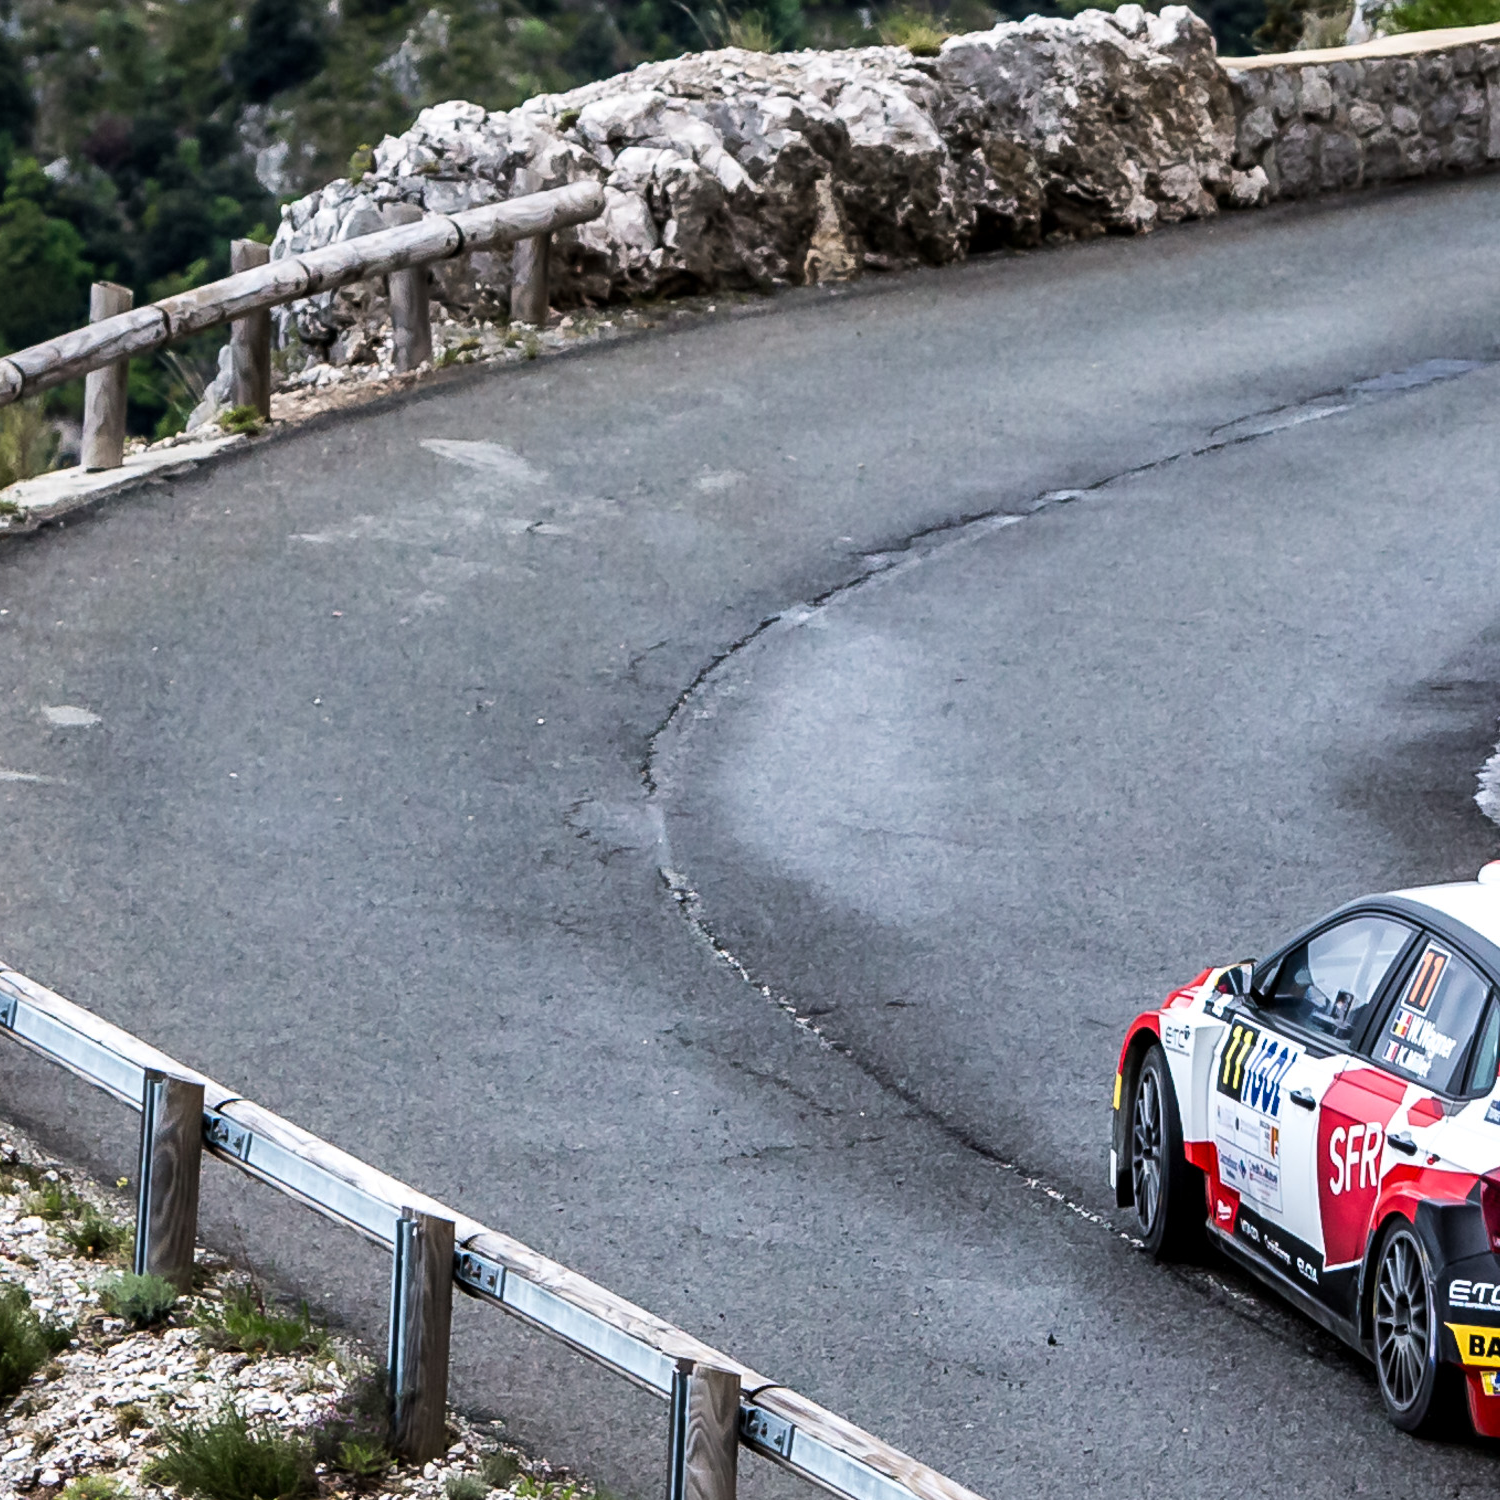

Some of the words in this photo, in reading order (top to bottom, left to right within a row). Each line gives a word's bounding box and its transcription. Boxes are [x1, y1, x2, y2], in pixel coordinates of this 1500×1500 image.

[1409, 952, 1445, 1007] 11
[1222, 1025, 1253, 1089] 11
[1243, 1038, 1298, 1116] IGOL
[1329, 1121, 1383, 1196] SFR
